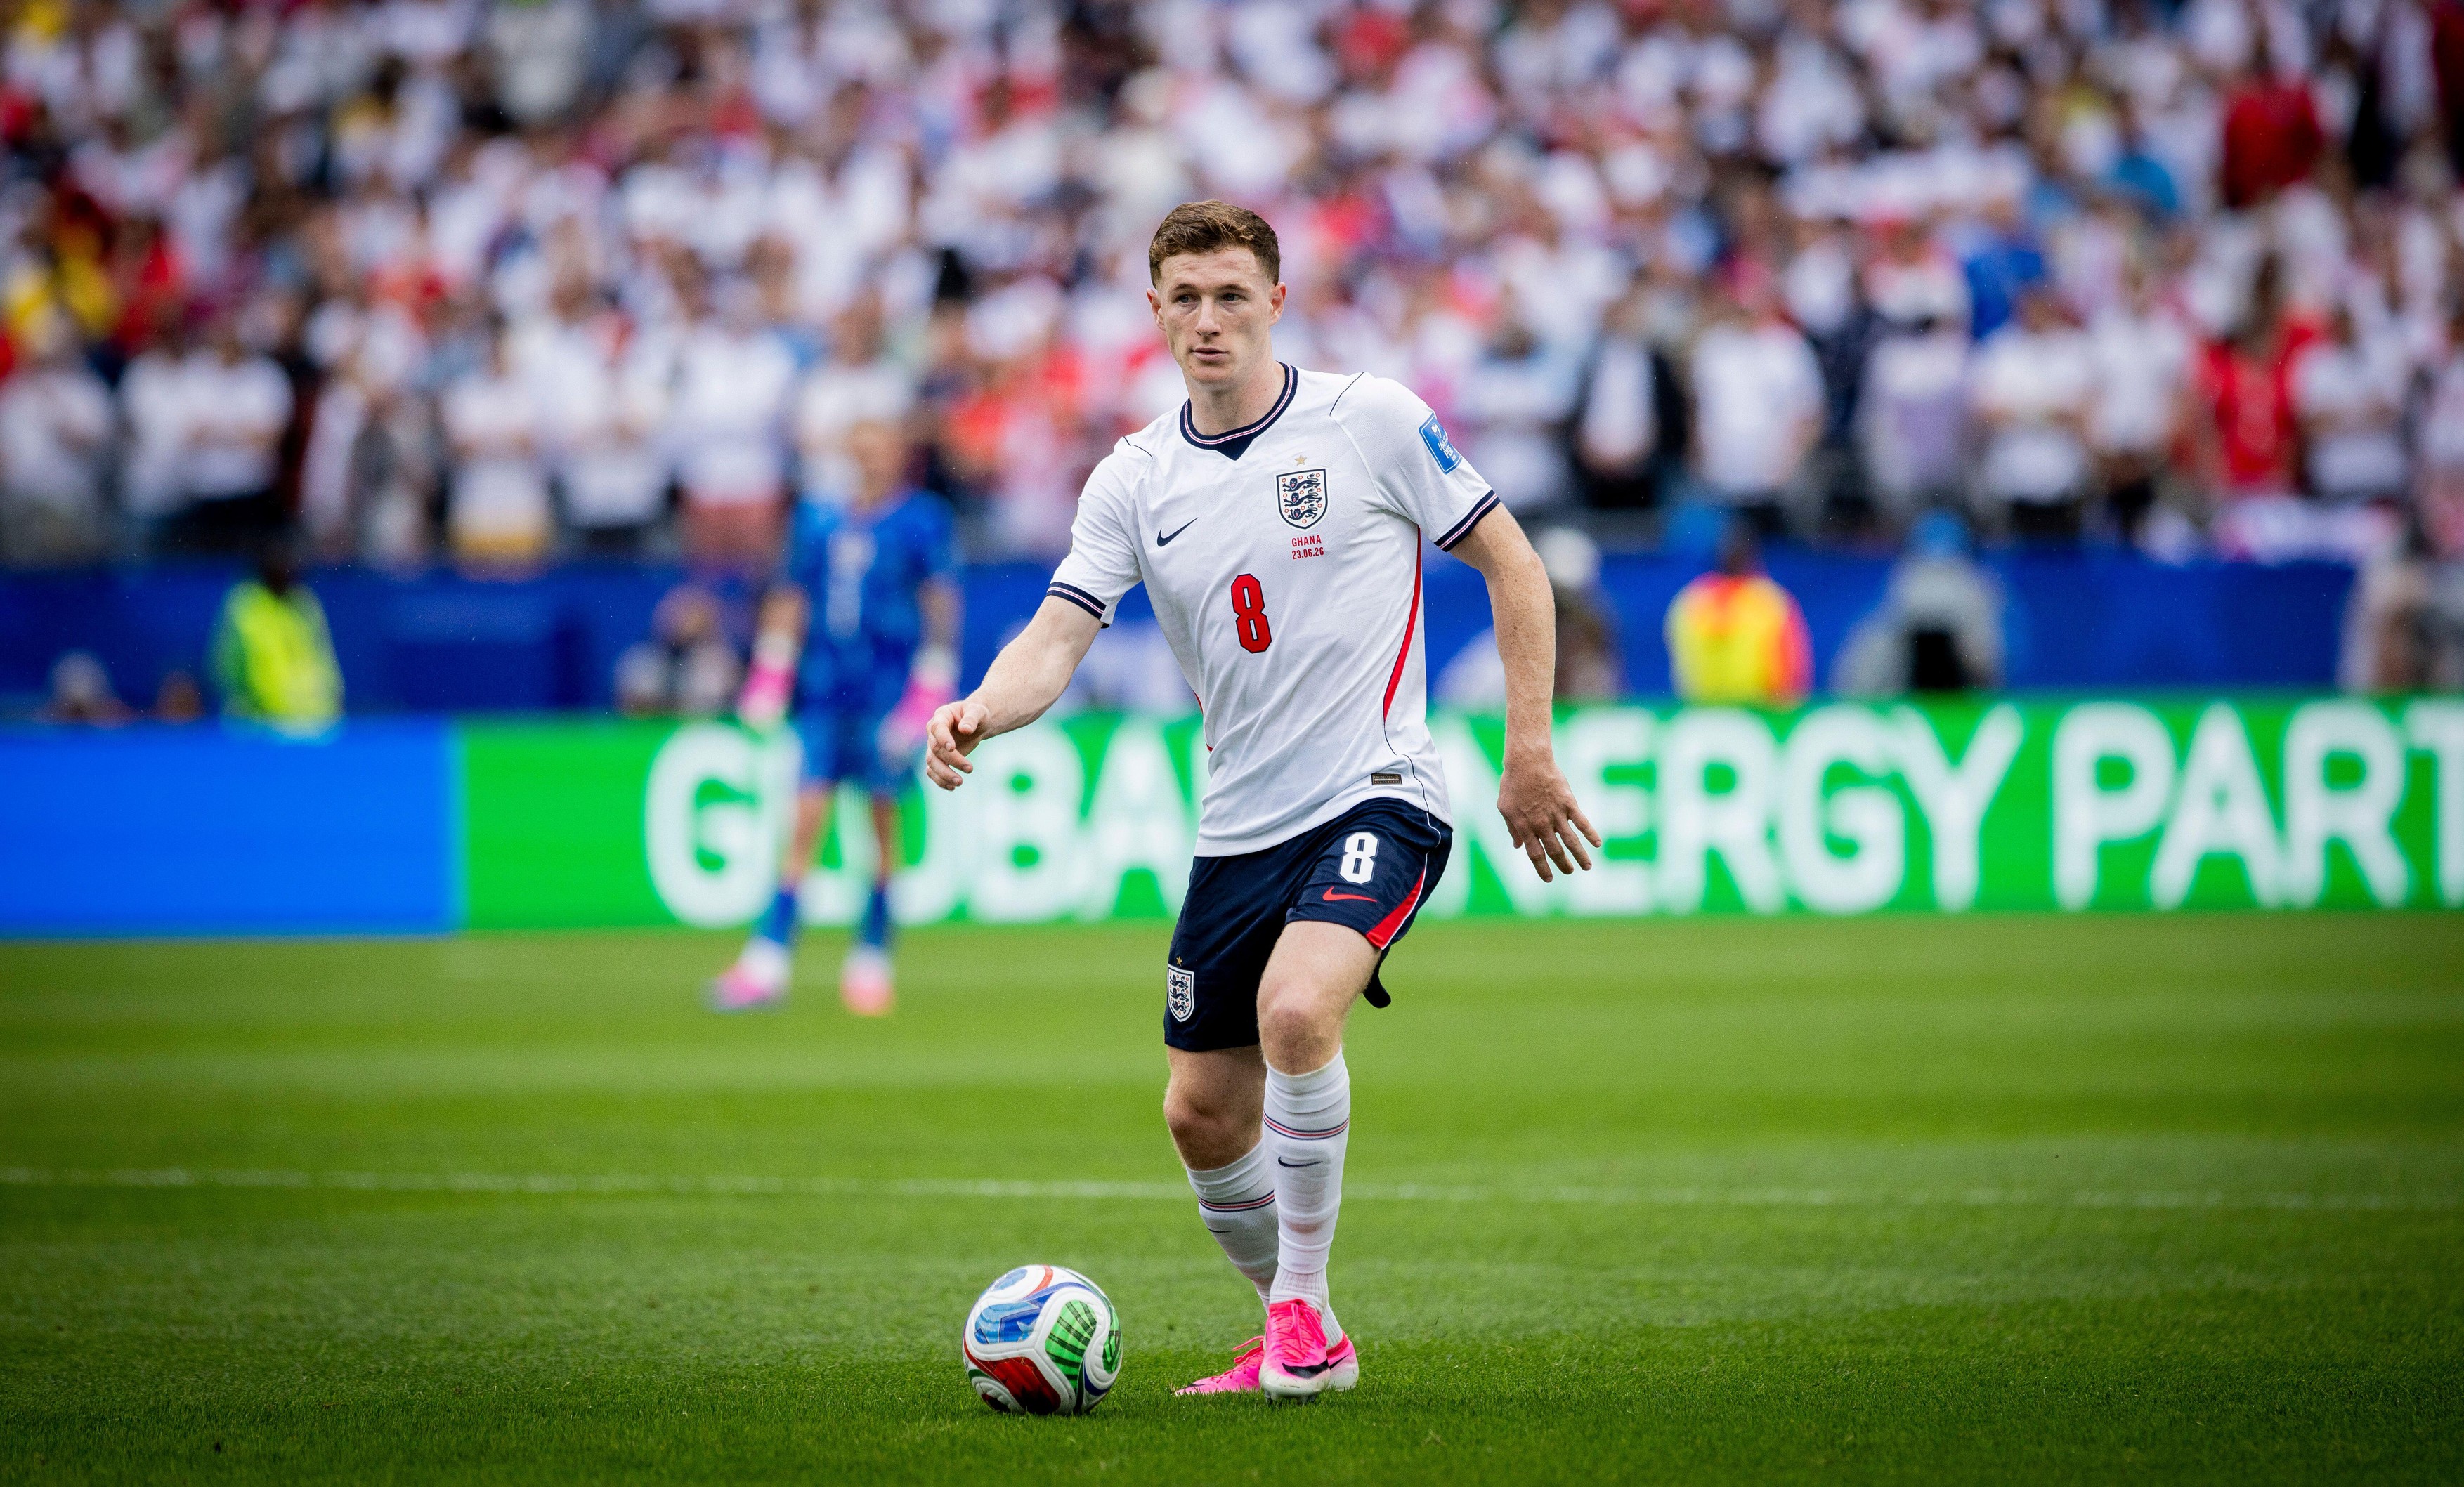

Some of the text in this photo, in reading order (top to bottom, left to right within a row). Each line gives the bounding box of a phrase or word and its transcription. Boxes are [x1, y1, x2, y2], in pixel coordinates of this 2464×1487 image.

[1291, 535, 1322, 546] GHANA
[1291, 546, 1324, 559] 23.06.26
[1231, 573, 1272, 654] 8
[1429, 704, 2025, 919] NERGY
[1338, 832, 1379, 885] 8
